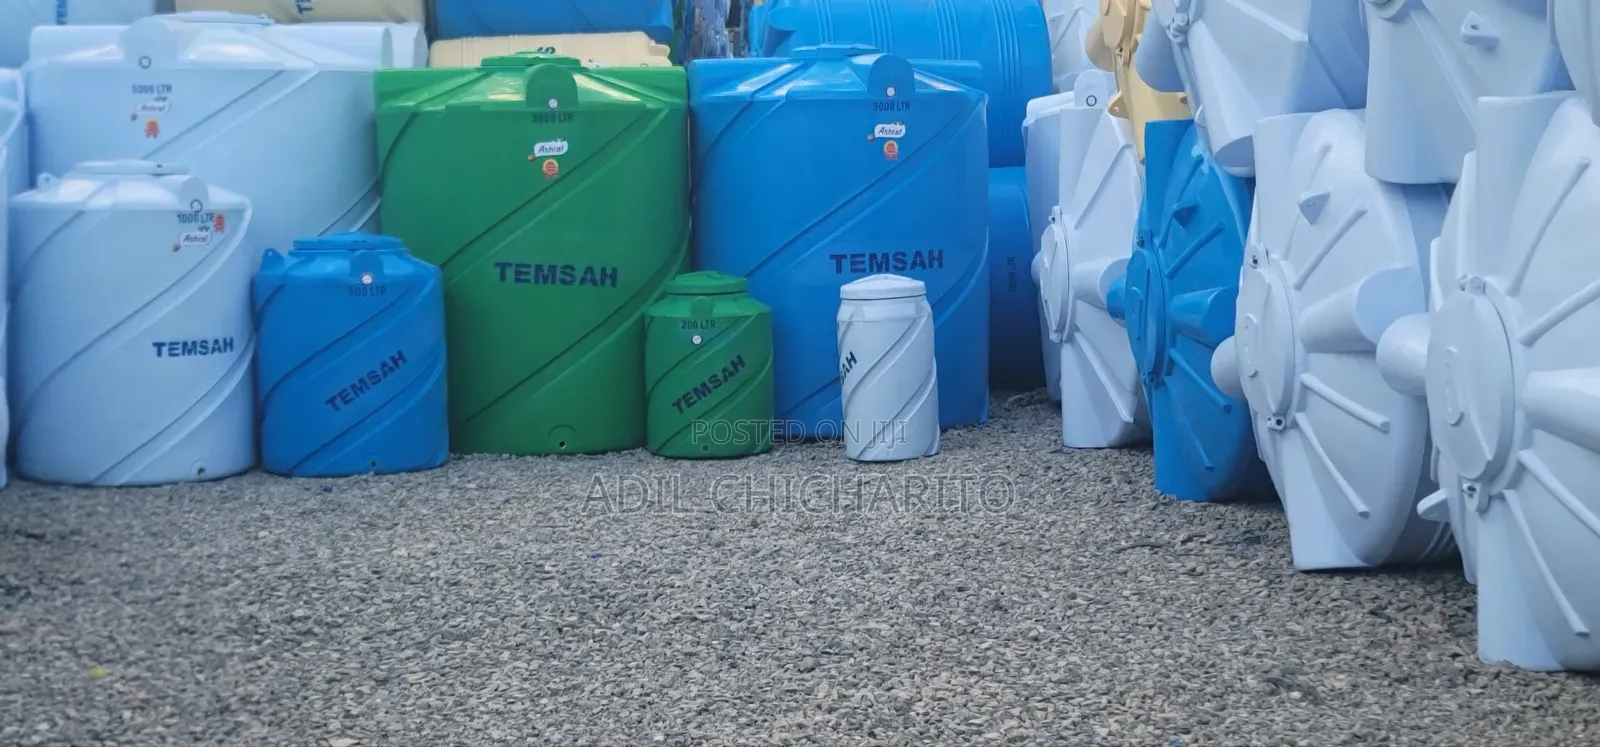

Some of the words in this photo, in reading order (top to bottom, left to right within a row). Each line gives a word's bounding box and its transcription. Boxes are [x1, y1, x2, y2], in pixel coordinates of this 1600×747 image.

[156, 84, 172, 94] LTR
[873, 102, 894, 111] 3000
[896, 101, 910, 111] LTR
[532, 113, 555, 123] 3000
[558, 113, 574, 123] LTR
[878, 126, 903, 135] Ashraf
[538, 145, 565, 153] Ashraf
[176, 213, 199, 223] 1000
[829, 248, 944, 274] TEMSAH
[494, 261, 618, 287] TEMSAH
[348, 286, 368, 297] 500
[370, 285, 387, 297] LTR
[681, 320, 698, 329] 200
[700, 319, 716, 329] LTR
[152, 337, 234, 358] TEMSAH
[325, 350, 407, 412] TEMSAH
[672, 354, 745, 414] TEMSAH
